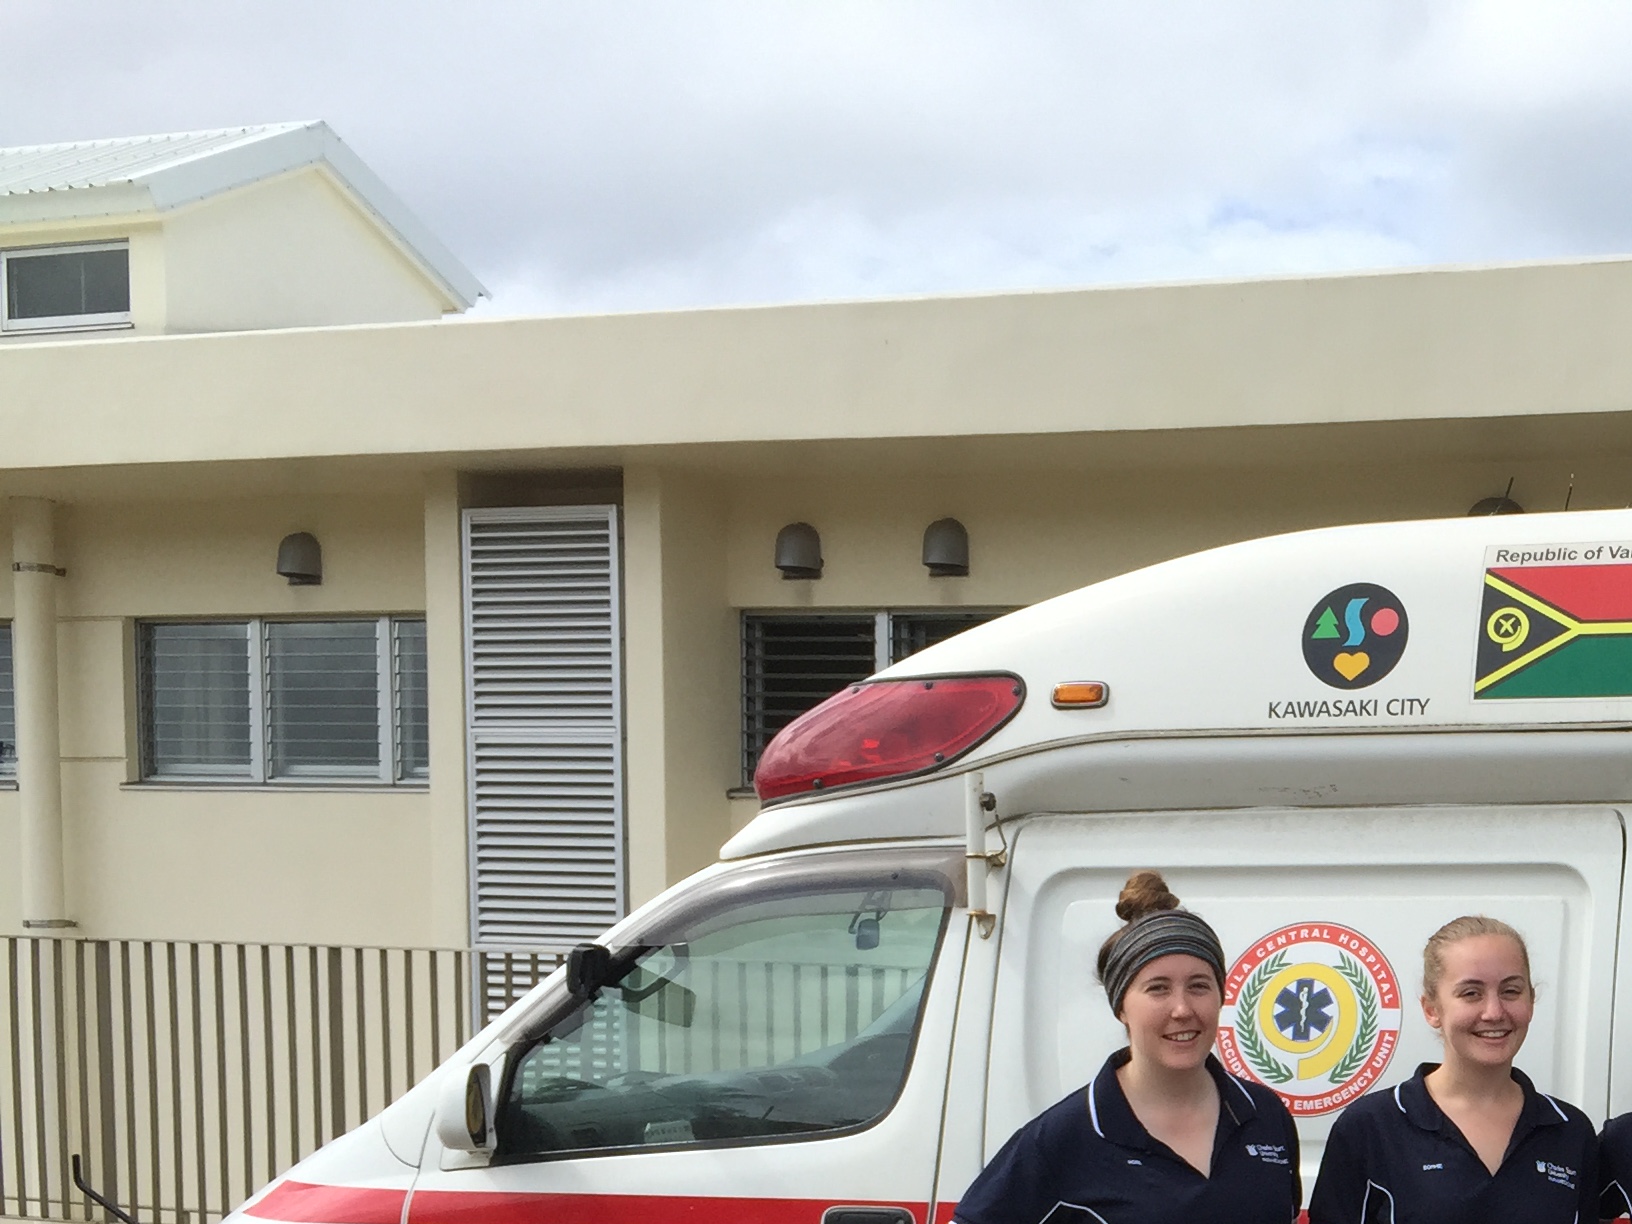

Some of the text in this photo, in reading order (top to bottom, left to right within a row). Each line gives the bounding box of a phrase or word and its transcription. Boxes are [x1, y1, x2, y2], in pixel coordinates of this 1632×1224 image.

[1496, 548, 1578, 565] Republic
[1584, 546, 1604, 560] of
[1268, 697, 1431, 719] KAWASAKI CITY
[1225, 928, 1394, 1004] VILA CENTRAL HOSPITAL
[1219, 1030, 1257, 1083] ACCIDE
[1293, 1032, 1395, 1111] EMERGENCY UNIT
